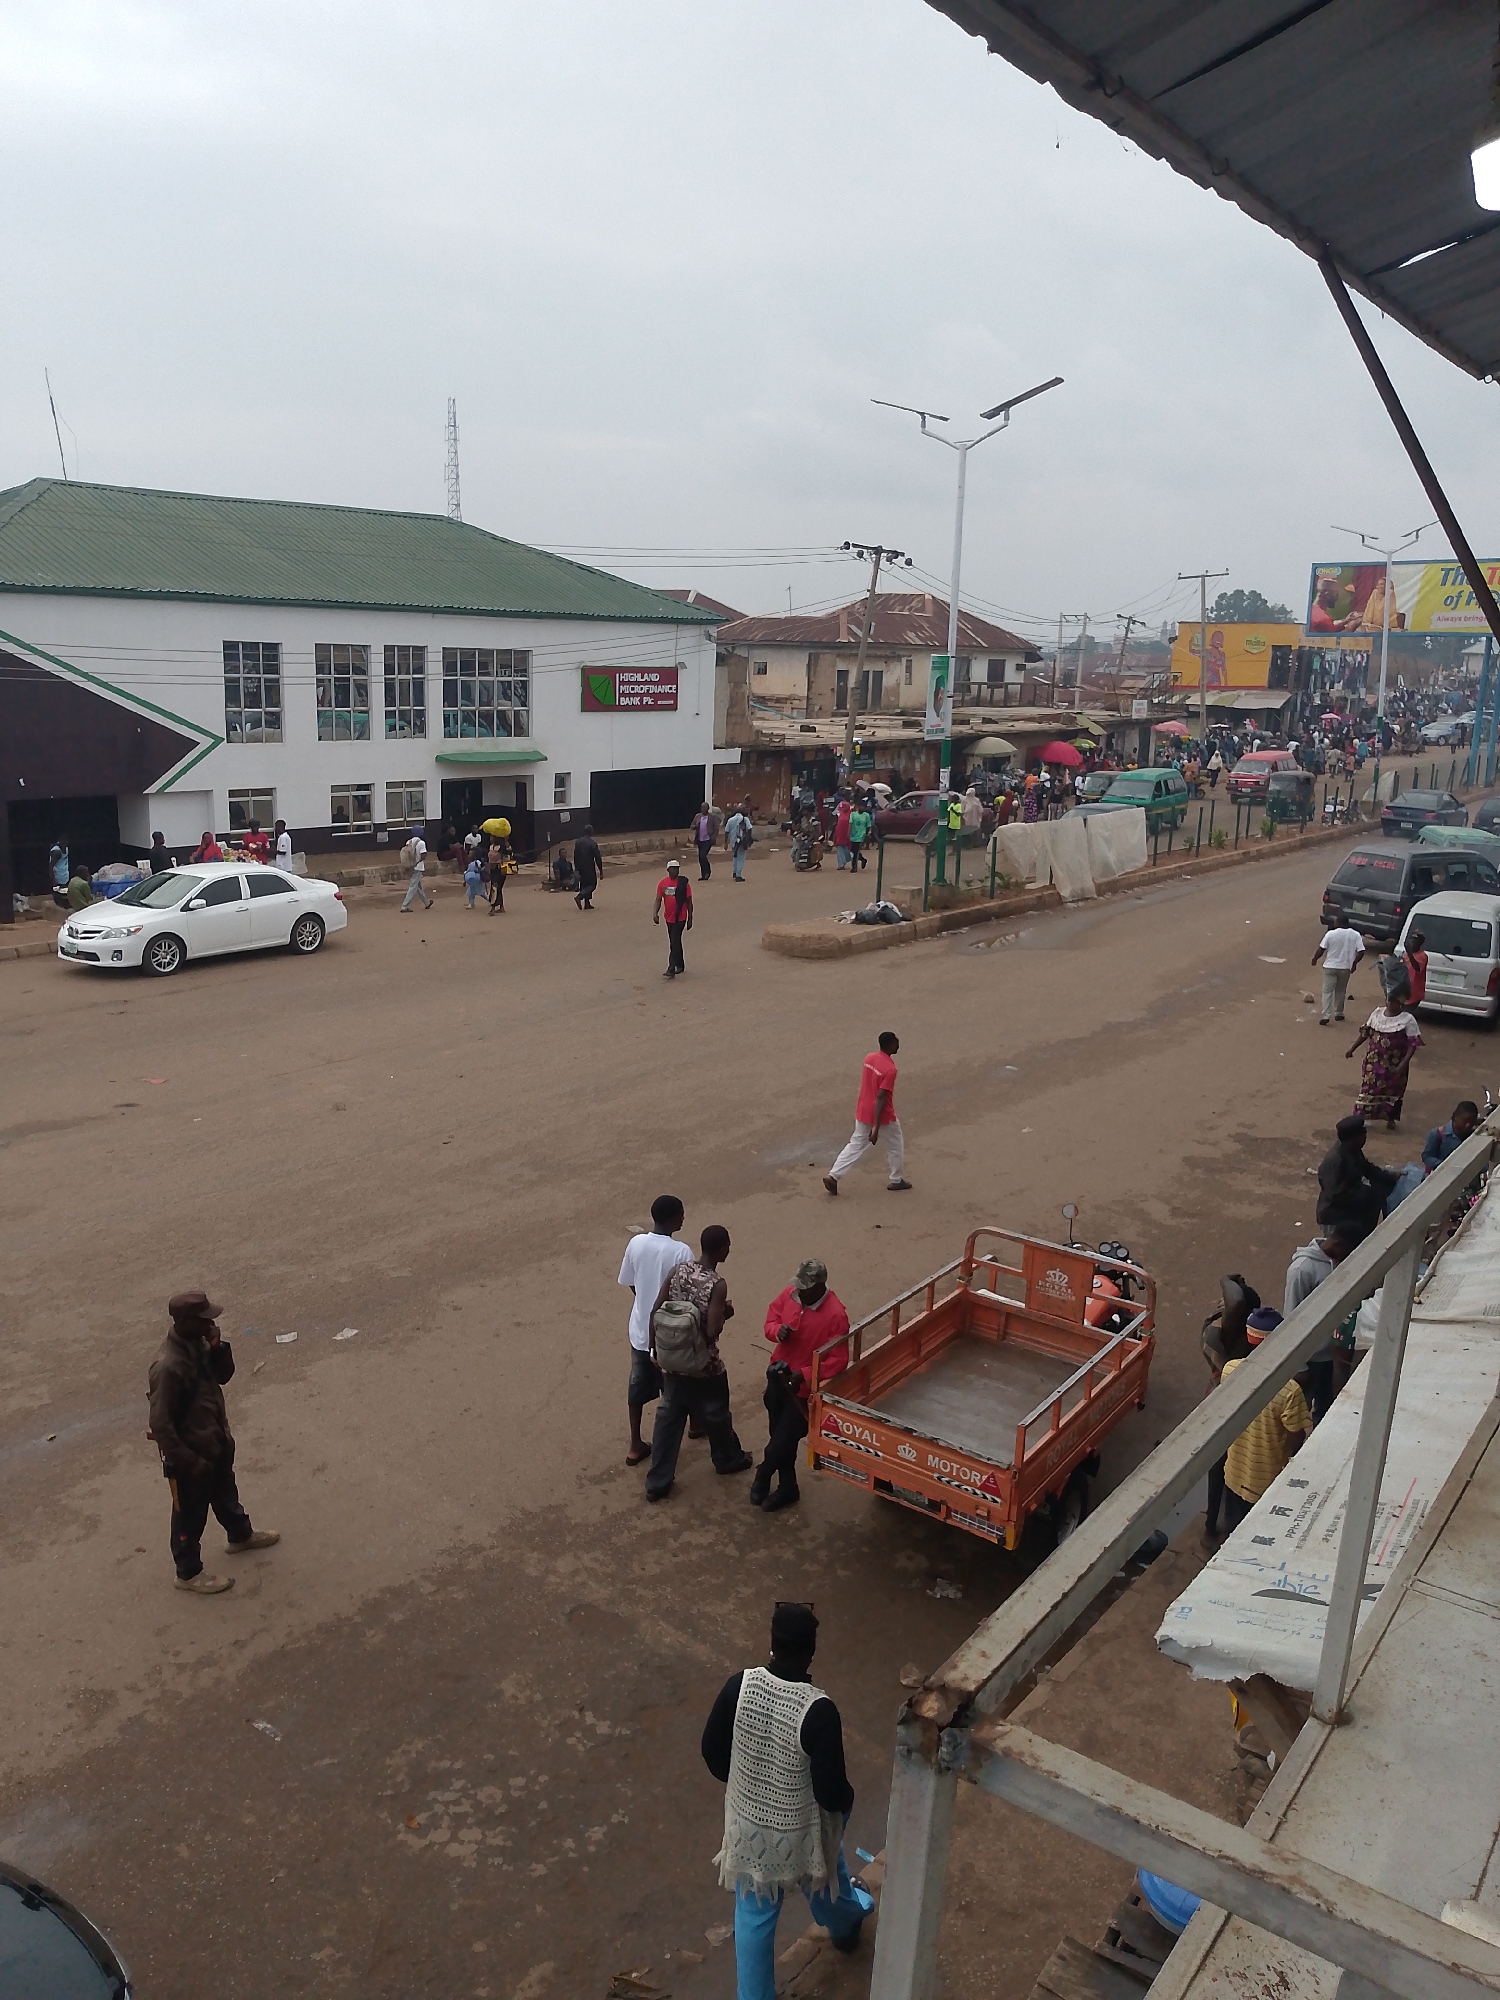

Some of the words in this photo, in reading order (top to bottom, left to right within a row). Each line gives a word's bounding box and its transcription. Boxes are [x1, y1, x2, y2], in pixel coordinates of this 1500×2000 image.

[1441, 566, 1471, 586] Th
[1487, 566, 1500, 586] T
[1444, 589, 1464, 610] of
[1436, 615, 1462, 624] Always
[620, 673, 660, 682] HIGHLAND
[620, 684, 677, 694] MICROFINANCE
[620, 697, 640, 705] BANK
[642, 697, 655, 705] Plc
[1038, 1280, 1074, 1295] ROYAL
[835, 1414, 881, 1447] ROYAL
[1046, 1429, 1079, 1471] ROYAL
